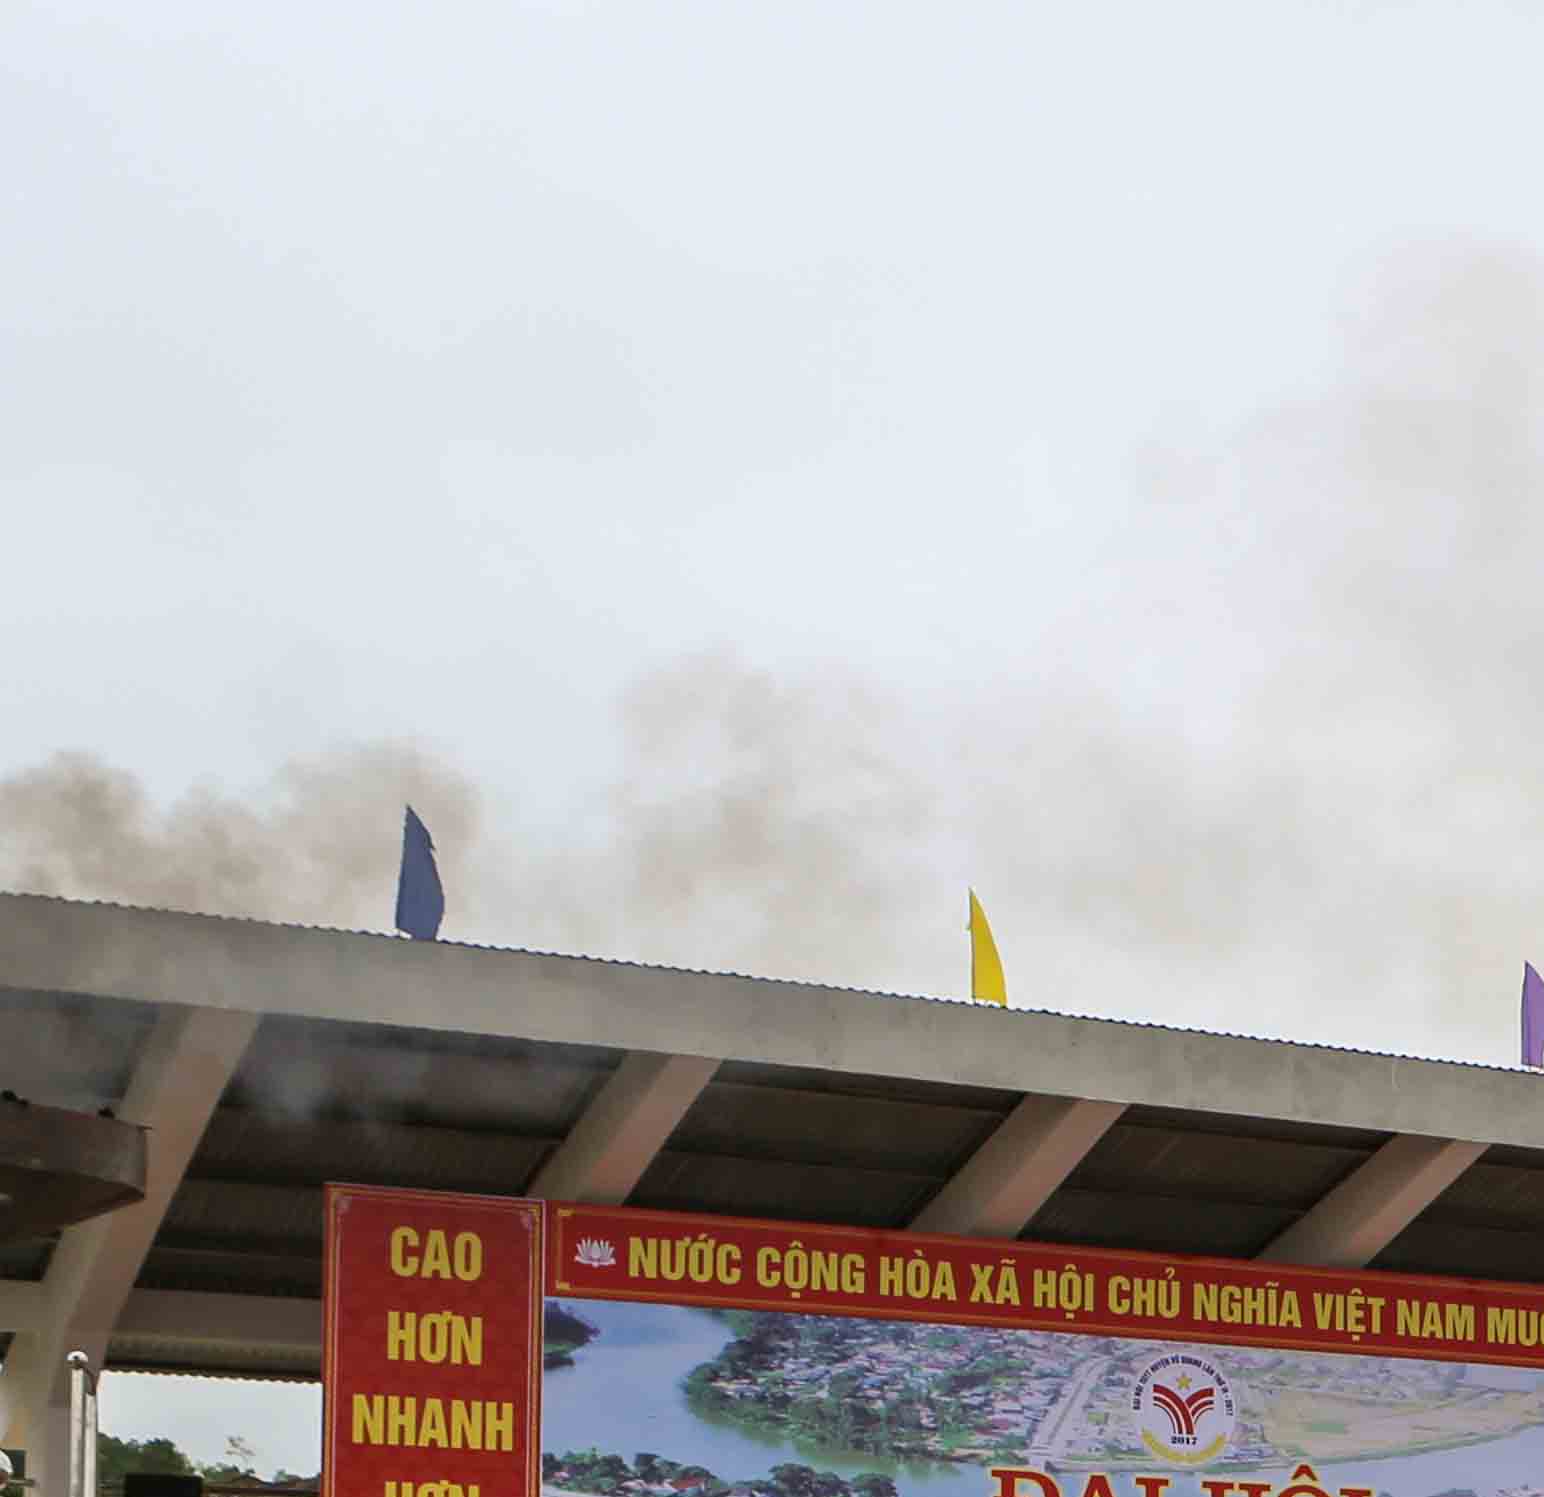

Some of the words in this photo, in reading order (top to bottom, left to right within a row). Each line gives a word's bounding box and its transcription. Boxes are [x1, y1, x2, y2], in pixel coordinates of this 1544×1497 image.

[390, 1225, 483, 1281] CAO
[628, 1233, 741, 1285] NƯỚC
[756, 1241, 866, 1299] CỘNG
[879, 1249, 957, 1302] HÒA
[969, 1258, 1022, 1307] XÃ
[1033, 1263, 1095, 1320] HỘI
[1107, 1267, 1181, 1320] CHỦ
[1193, 1281, 1302, 1328] NGHĨA
[1312, 1287, 1386, 1342] VIỆT
[1396, 1298, 1476, 1342] NAM
[386, 1310, 483, 1367] HƠN
[352, 1393, 514, 1452] NHANH
[1170, 1436, 1198, 1446] 2017
